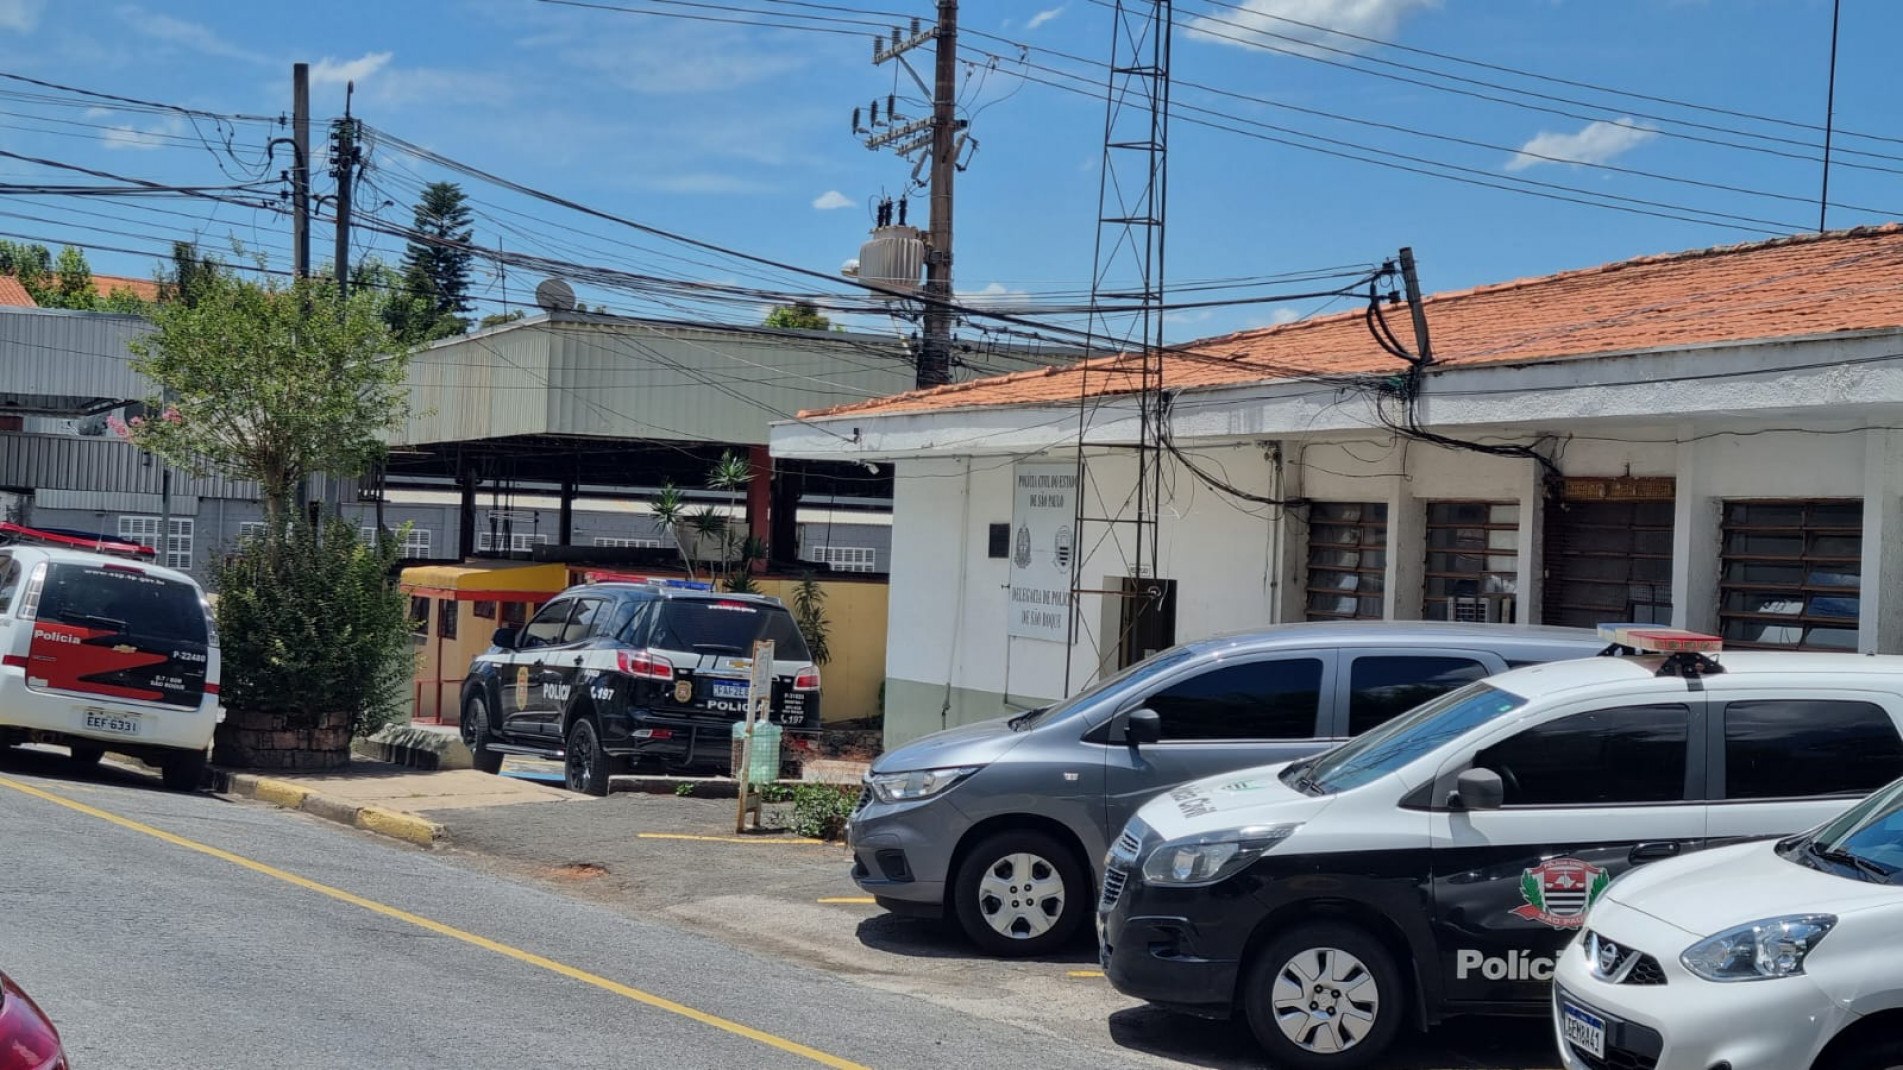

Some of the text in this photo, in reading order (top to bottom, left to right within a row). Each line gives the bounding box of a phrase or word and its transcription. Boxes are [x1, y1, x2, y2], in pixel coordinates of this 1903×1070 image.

[1018, 472, 1037, 488] POLÍCIA
[1038, 475, 1050, 488] CIVIL
[1050, 475, 1058, 488] DO
[1029, 490, 1064, 508] DE SÃO PAULO
[1011, 587, 1042, 604] DELEGACIA
[1042, 589, 1051, 605] DE
[1021, 608, 1061, 629] DE SÃO ROQUE
[34, 629, 81, 645] Polícia
[598, 687, 615, 701] 197
[87, 716, 136, 731] EEF-6331
[788, 715, 804, 724] 197
[1457, 949, 1565, 980] Políc
